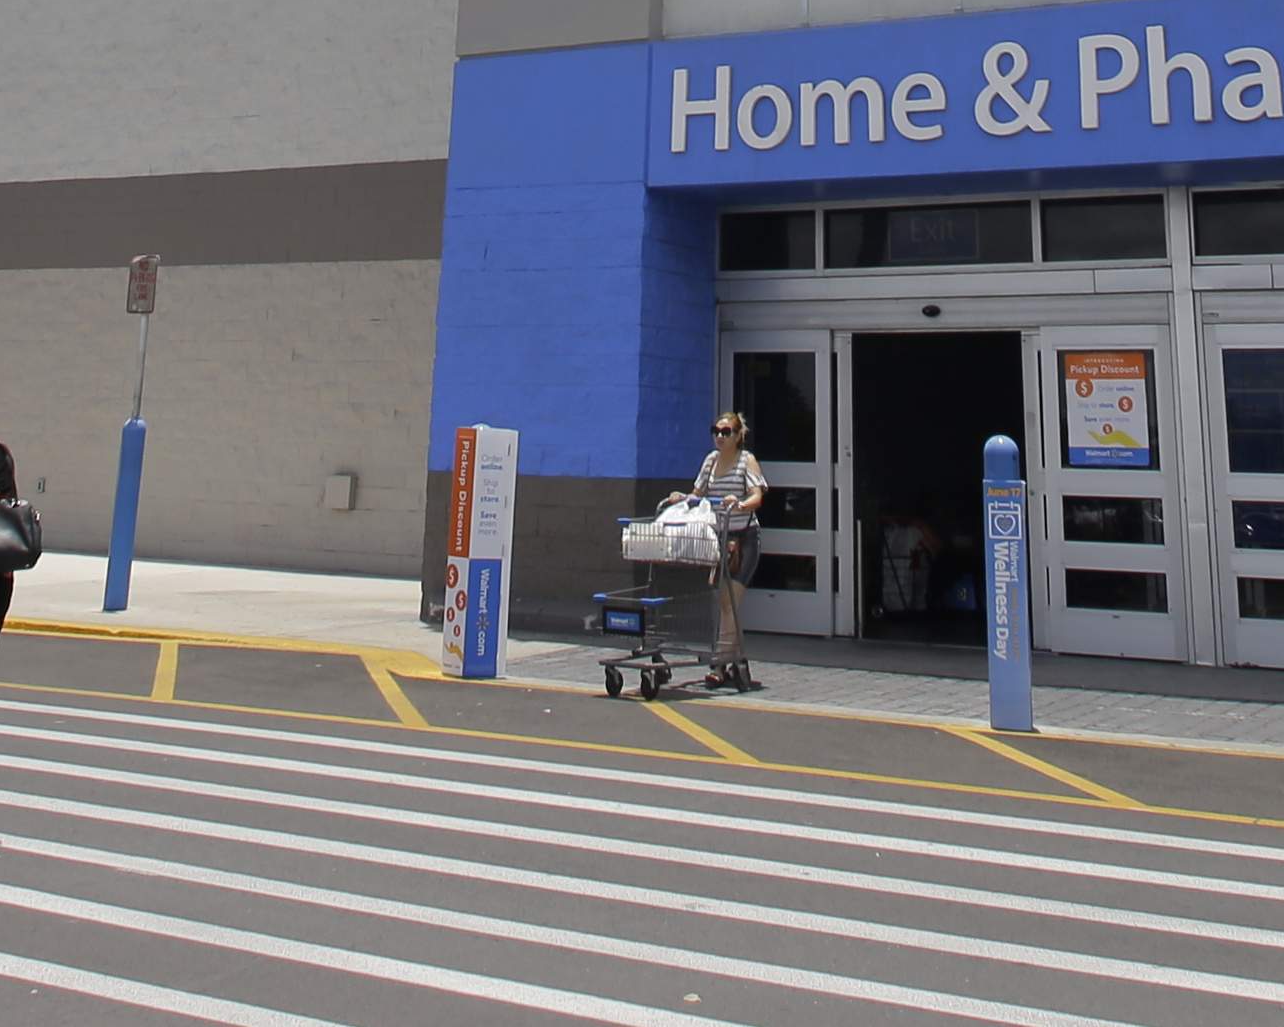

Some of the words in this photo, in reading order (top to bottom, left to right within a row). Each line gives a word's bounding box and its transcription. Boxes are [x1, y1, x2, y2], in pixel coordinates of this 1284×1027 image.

[669, 63, 945, 154] Home
[973, 40, 1052, 136] &
[910, 216, 956, 243] Exit
[1070, 364, 1099, 376] Pickup
[1100, 364, 1140, 375] Discount
[457, 440, 471, 487] Pickup
[987, 486, 1008, 497] June
[1010, 486, 1021, 498] 17
[454, 490, 468, 552] Discount
[480, 510, 497, 520] Save
[1010, 540, 1020, 582] Walmart
[479, 568, 491, 614] Walmart
[994, 541, 1011, 625] Wellness
[994, 629, 1009, 660] Day
